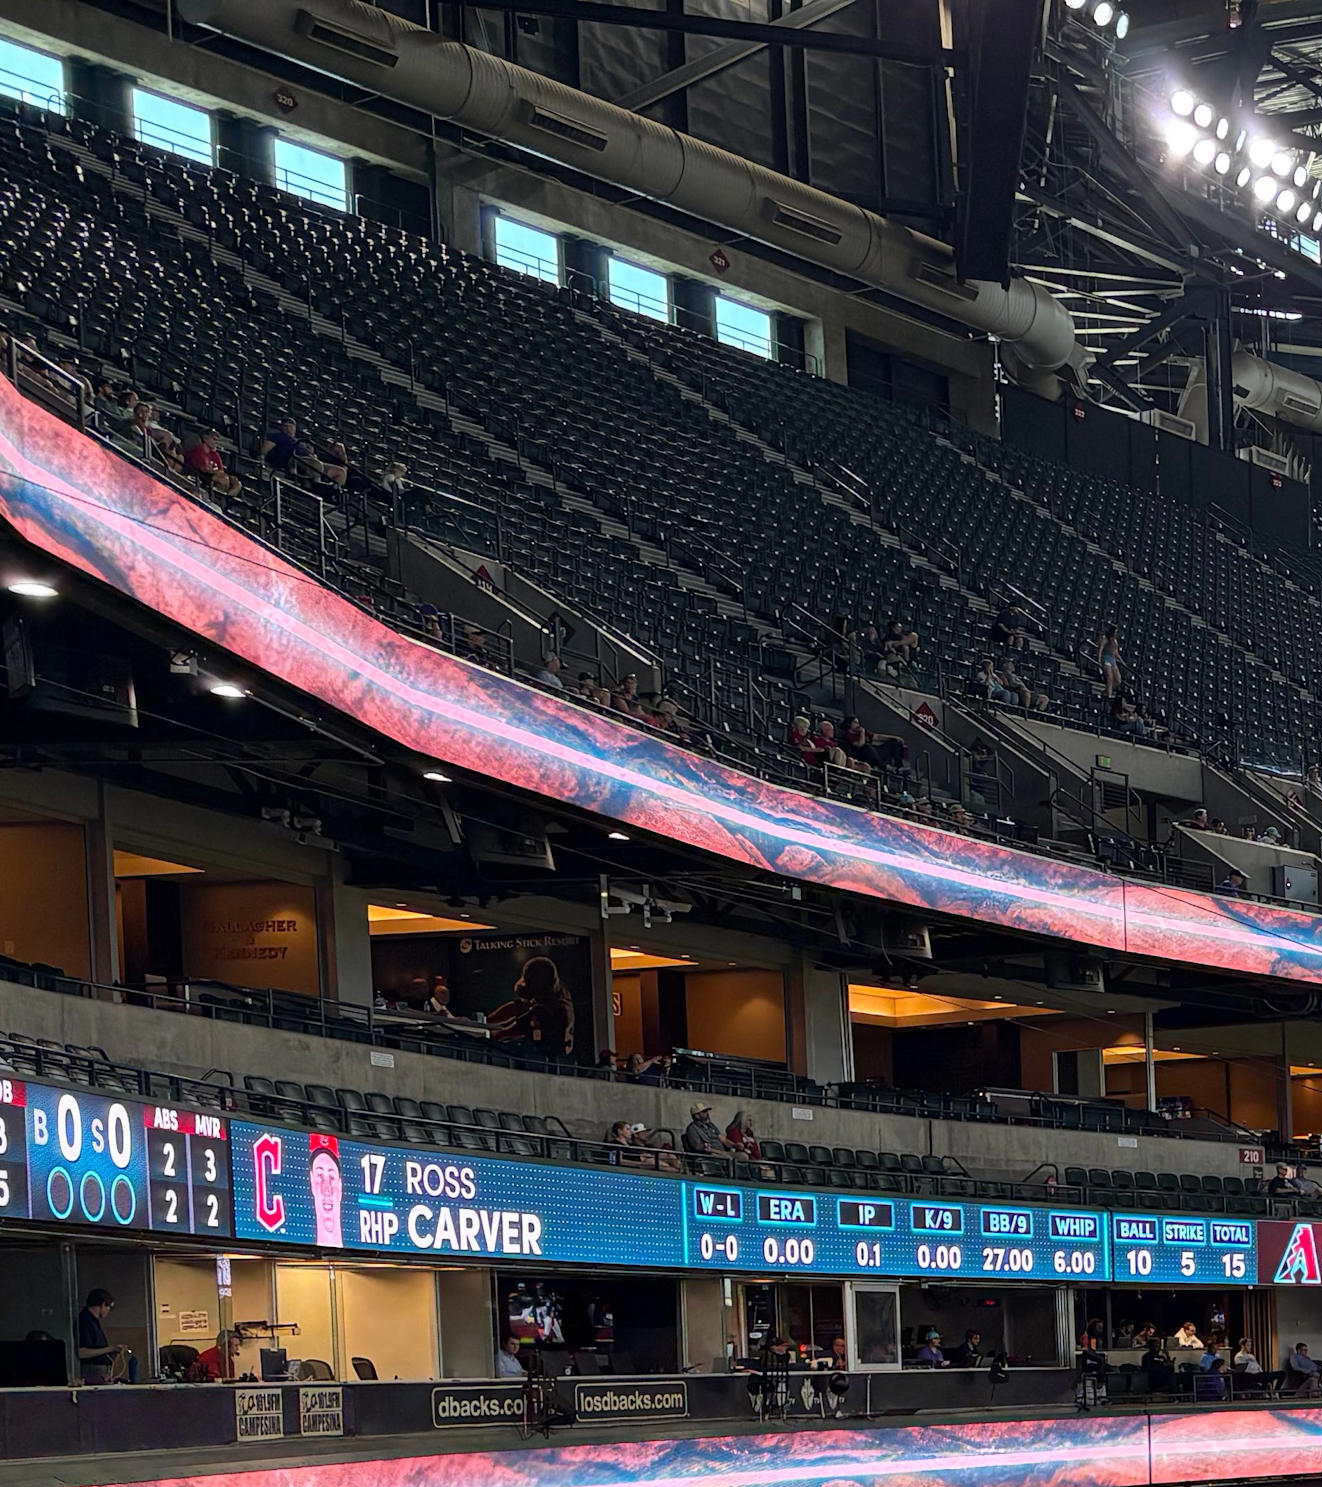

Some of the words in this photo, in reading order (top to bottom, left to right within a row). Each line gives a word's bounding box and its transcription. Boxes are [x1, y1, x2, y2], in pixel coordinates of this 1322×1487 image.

[212, 919, 298, 934] ALLAGHER
[474, 937, 513, 951] TALKING
[515, 936, 541, 949] STICK
[34, 1108, 48, 1145] B
[58, 1094, 82, 1162] 0
[91, 1118, 104, 1153] S
[108, 1103, 131, 1169] 0
[154, 1107, 178, 1130] ABS
[194, 1114, 220, 1139] MVR
[163, 1143, 176, 1177] 2
[204, 1149, 216, 1182] 3
[1244, 1151, 1258, 1162] 210
[360, 1154, 385, 1194] 17
[406, 1161, 476, 1199] ROSS
[165, 1189, 177, 1223] 2
[207, 1194, 219, 1227] 2
[769, 1199, 805, 1221] ERA
[858, 1205, 876, 1225] IP
[924, 1209, 952, 1229] K/9
[989, 1213, 1027, 1233] BB/9
[1056, 1217, 1095, 1237] WHIP
[359, 1210, 398, 1245] RHP
[407, 1204, 542, 1255] CARVER
[1120, 1222, 1154, 1239] BALL
[1165, 1224, 1204, 1241] STRIKE
[1213, 1226, 1249, 1242] TOTAL
[701, 1233, 738, 1262] 0-0
[763, 1237, 814, 1265] 0.00
[856, 1241, 881, 1267] 0.1
[917, 1245, 962, 1269] 0.00
[982, 1247, 1033, 1272] 27.00
[1053, 1250, 1095, 1274] 6.00
[1126, 1250, 1152, 1275] 10
[1181, 1251, 1196, 1277] 5
[1221, 1253, 1246, 1278] 15
[438, 1394, 527, 1418] dbacks.co
[580, 1390, 683, 1412] losdbacks.com
